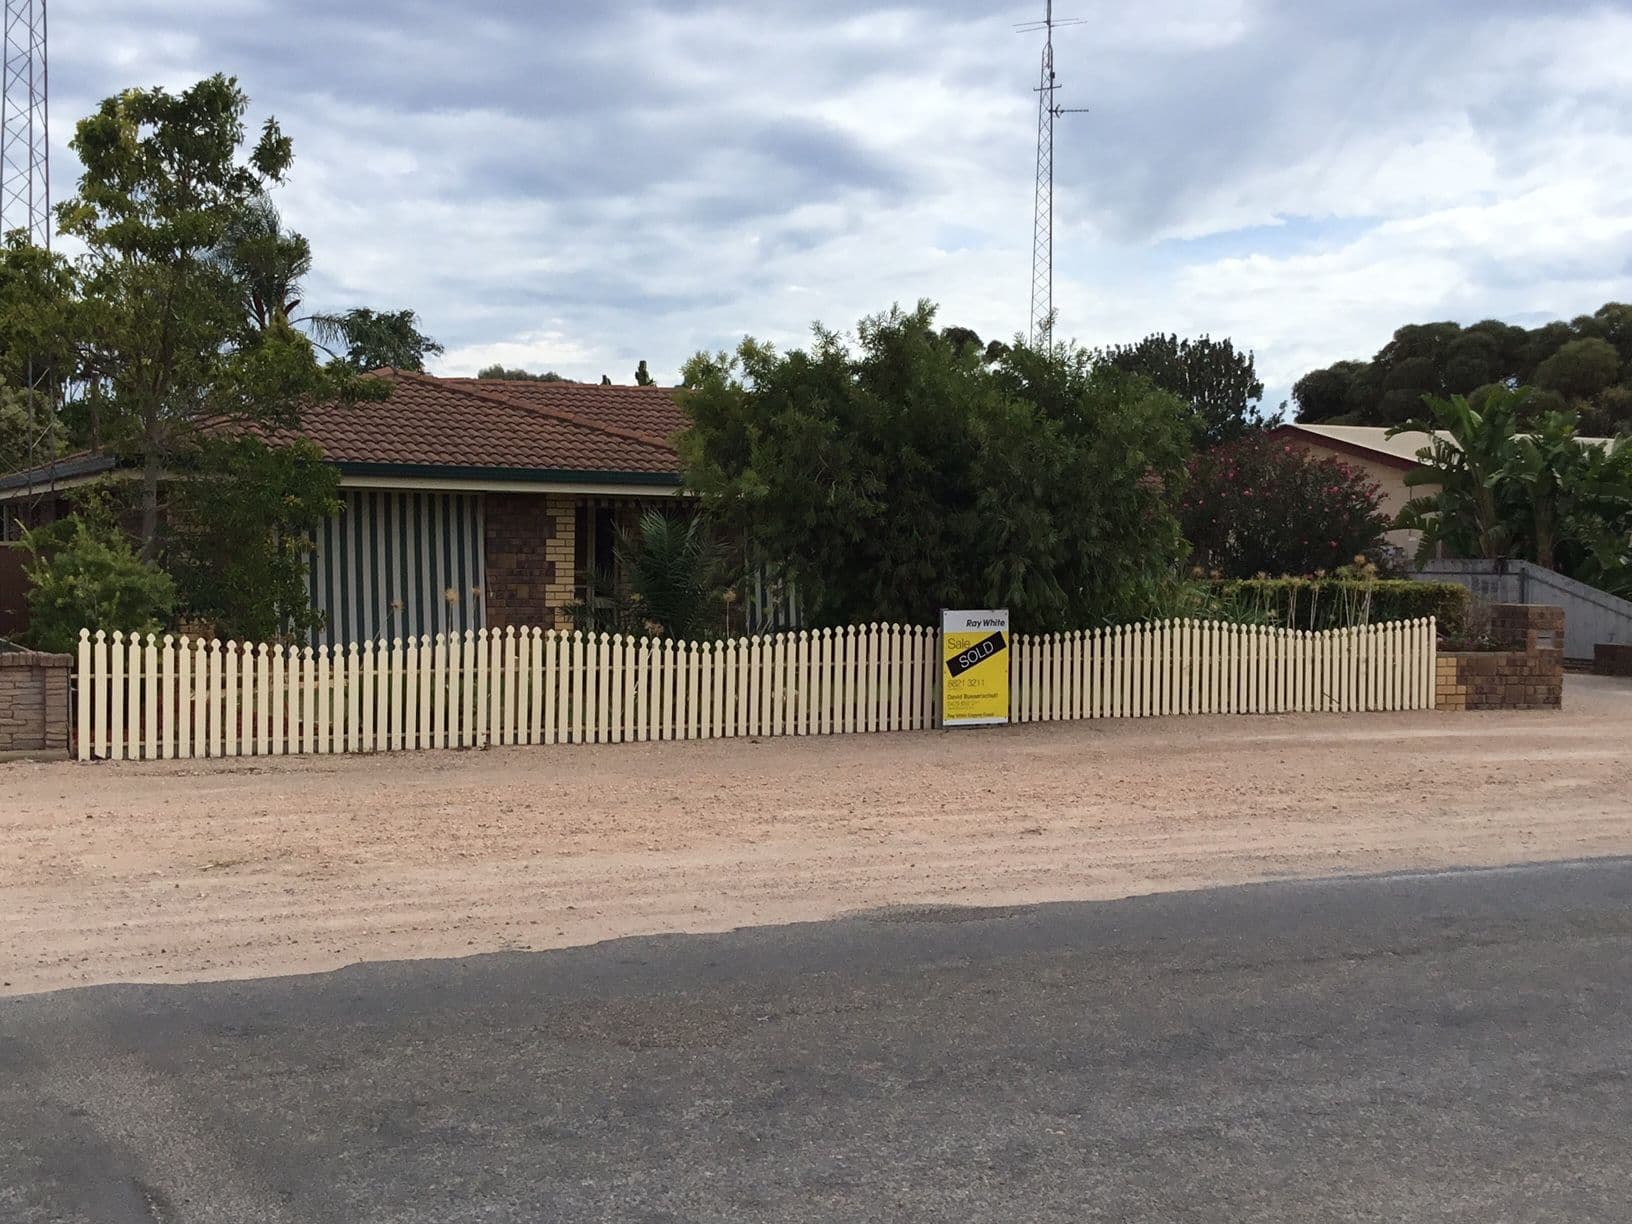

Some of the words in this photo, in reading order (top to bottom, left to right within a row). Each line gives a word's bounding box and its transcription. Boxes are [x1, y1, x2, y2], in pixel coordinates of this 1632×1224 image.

[966, 619, 981, 628] Ray
[983, 619, 1006, 627] White
[947, 637, 970, 650] Sale
[959, 641, 994, 668] SOLD
